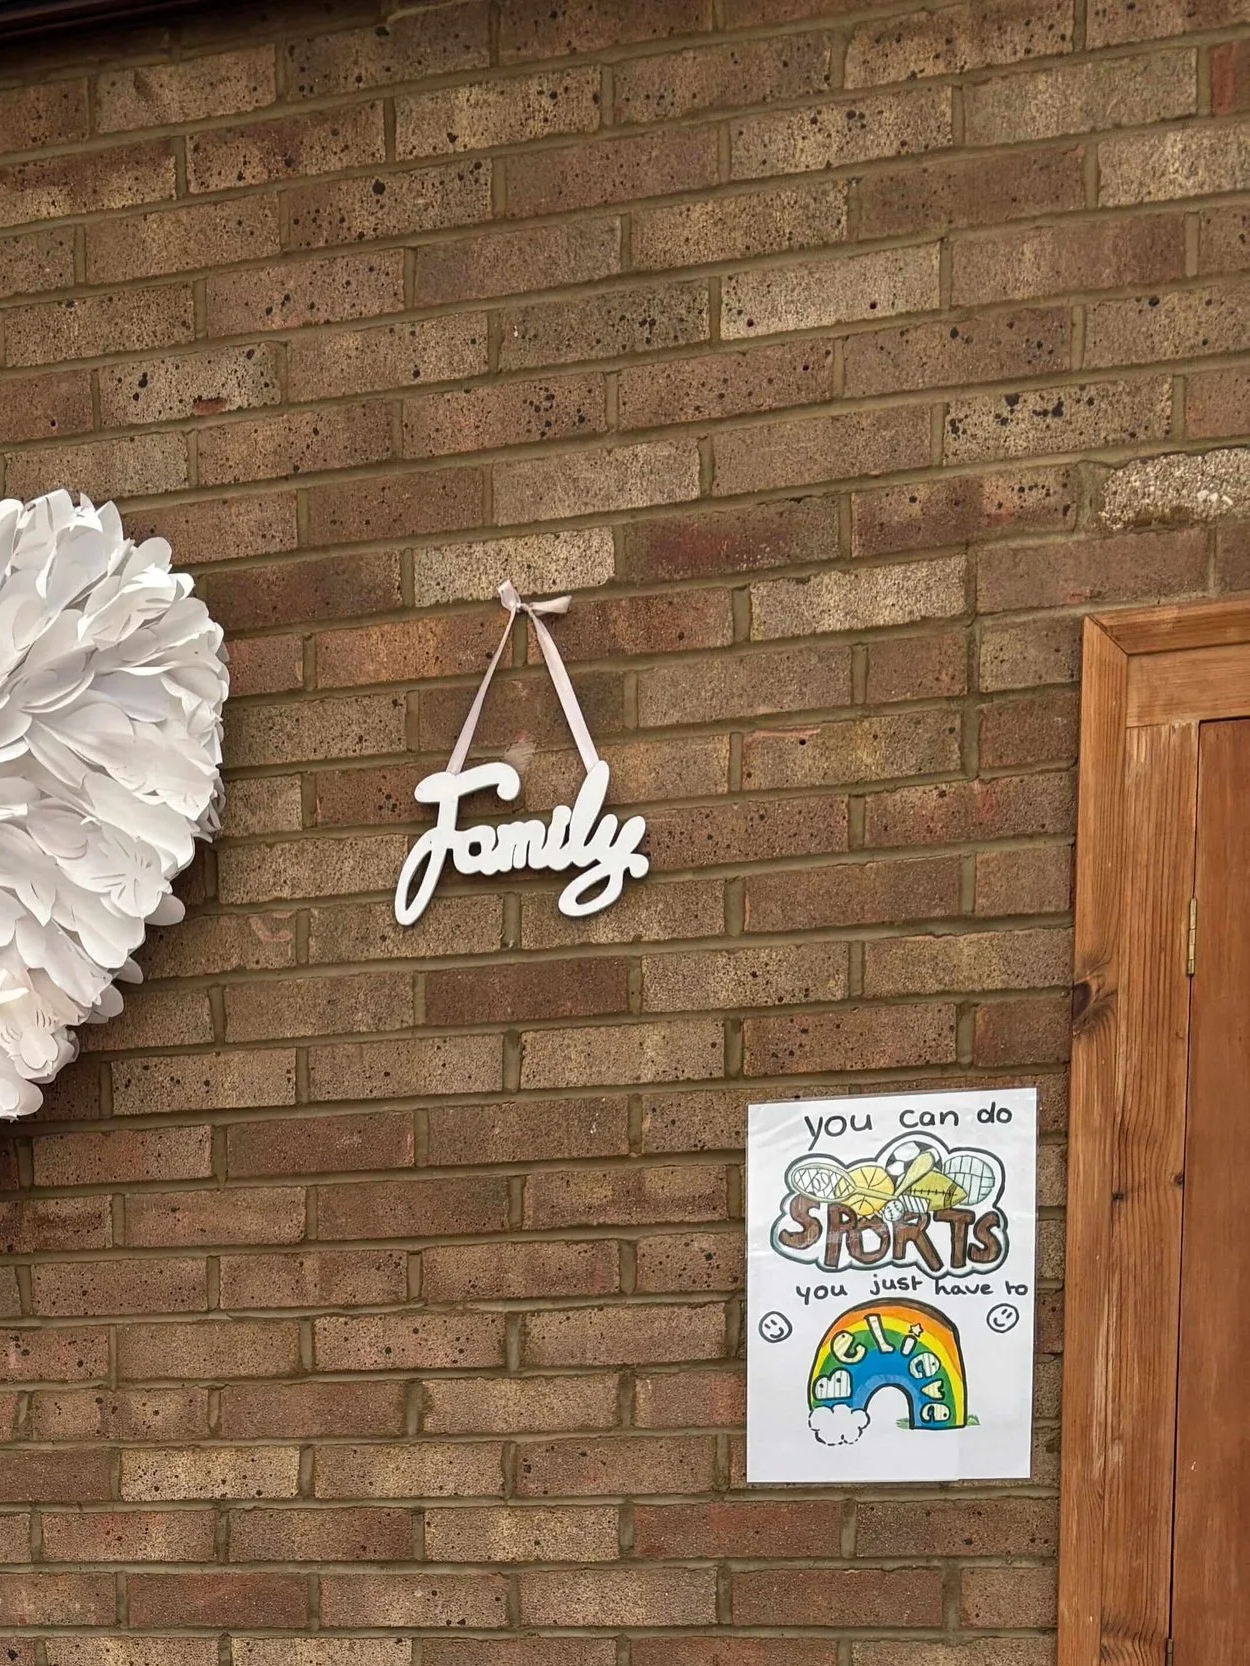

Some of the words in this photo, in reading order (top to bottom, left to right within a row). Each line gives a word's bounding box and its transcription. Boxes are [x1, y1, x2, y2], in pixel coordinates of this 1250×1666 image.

[394, 759, 650, 926] Family
[804, 1112, 873, 1151] you
[898, 1105, 959, 1127] can
[976, 1101, 1013, 1126] do
[778, 1190, 1003, 1273] SPORTS
[795, 1280, 848, 1306] you
[869, 1274, 923, 1297] just
[934, 1277, 993, 1297] have
[1005, 1280, 1029, 1296] to
